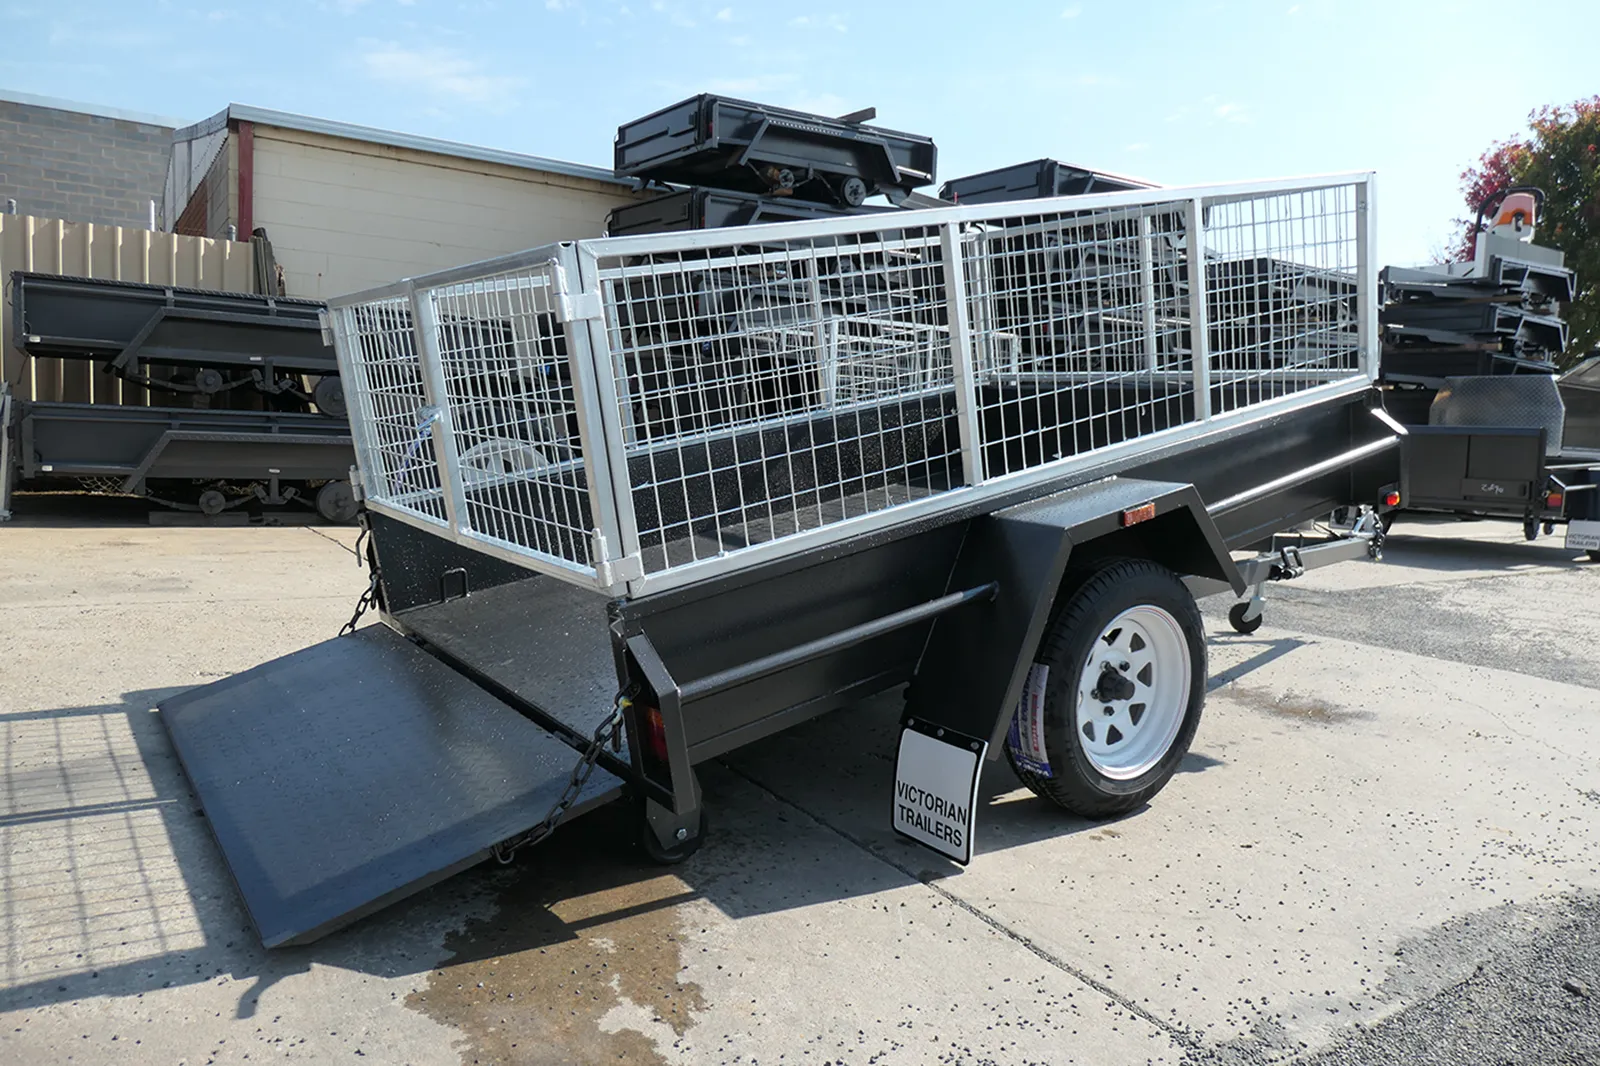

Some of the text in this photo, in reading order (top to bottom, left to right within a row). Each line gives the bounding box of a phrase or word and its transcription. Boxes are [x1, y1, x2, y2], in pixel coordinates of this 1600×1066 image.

[1568, 539, 1598, 547] TRAILERS
[897, 780, 967, 826] VICTORIAN
[898, 804, 962, 848] TRAILERS
